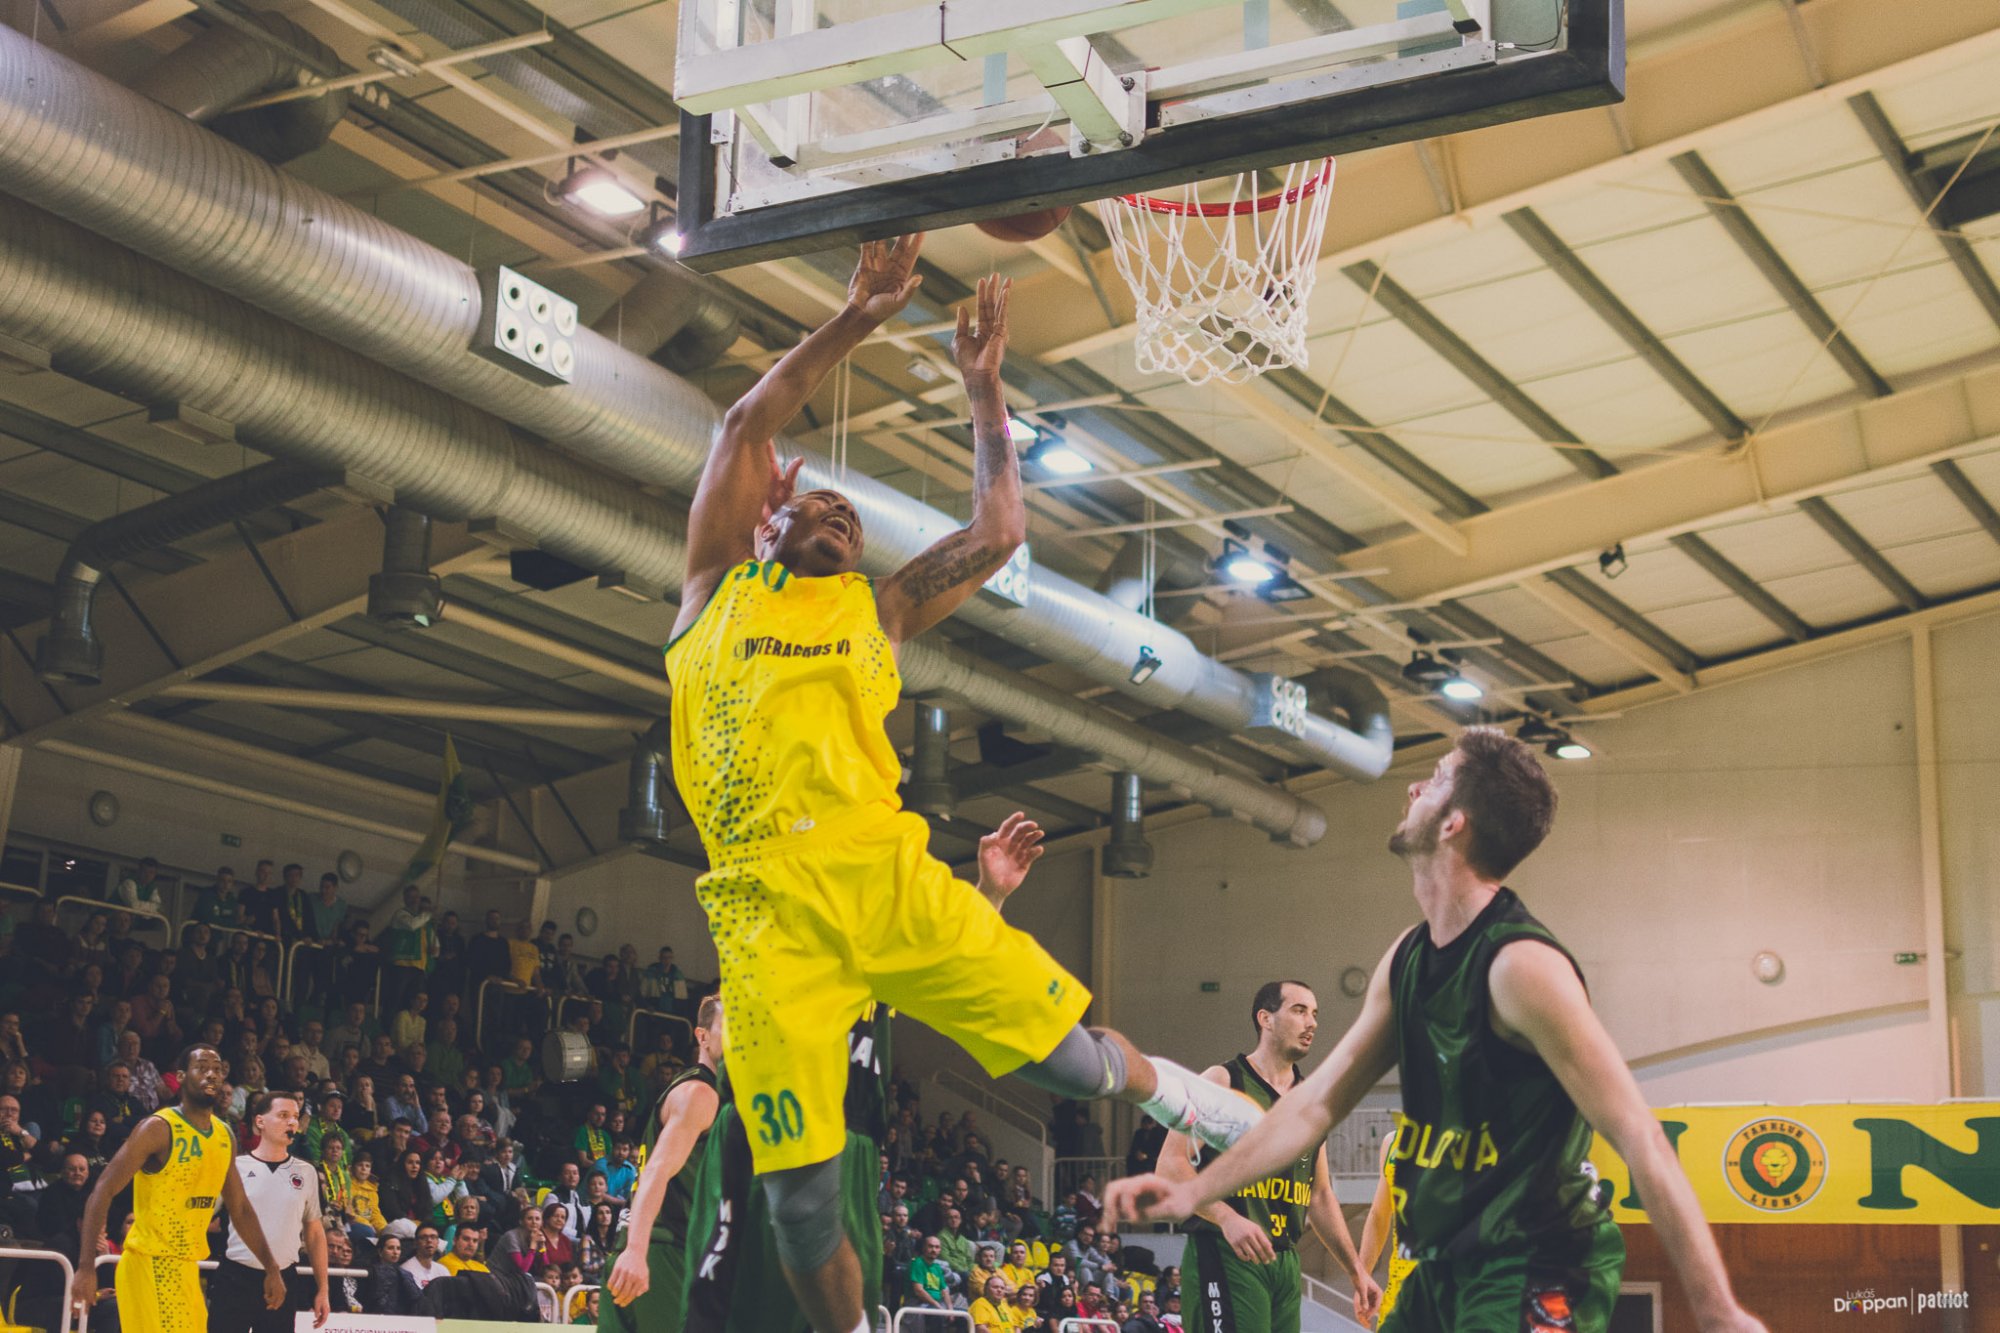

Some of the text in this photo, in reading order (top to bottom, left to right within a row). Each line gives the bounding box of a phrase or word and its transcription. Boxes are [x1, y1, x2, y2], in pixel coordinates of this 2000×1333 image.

[752, 1088, 804, 1146] 30
[175, 1135, 203, 1164] 24
[1750, 1193, 1803, 1208] LIONS
